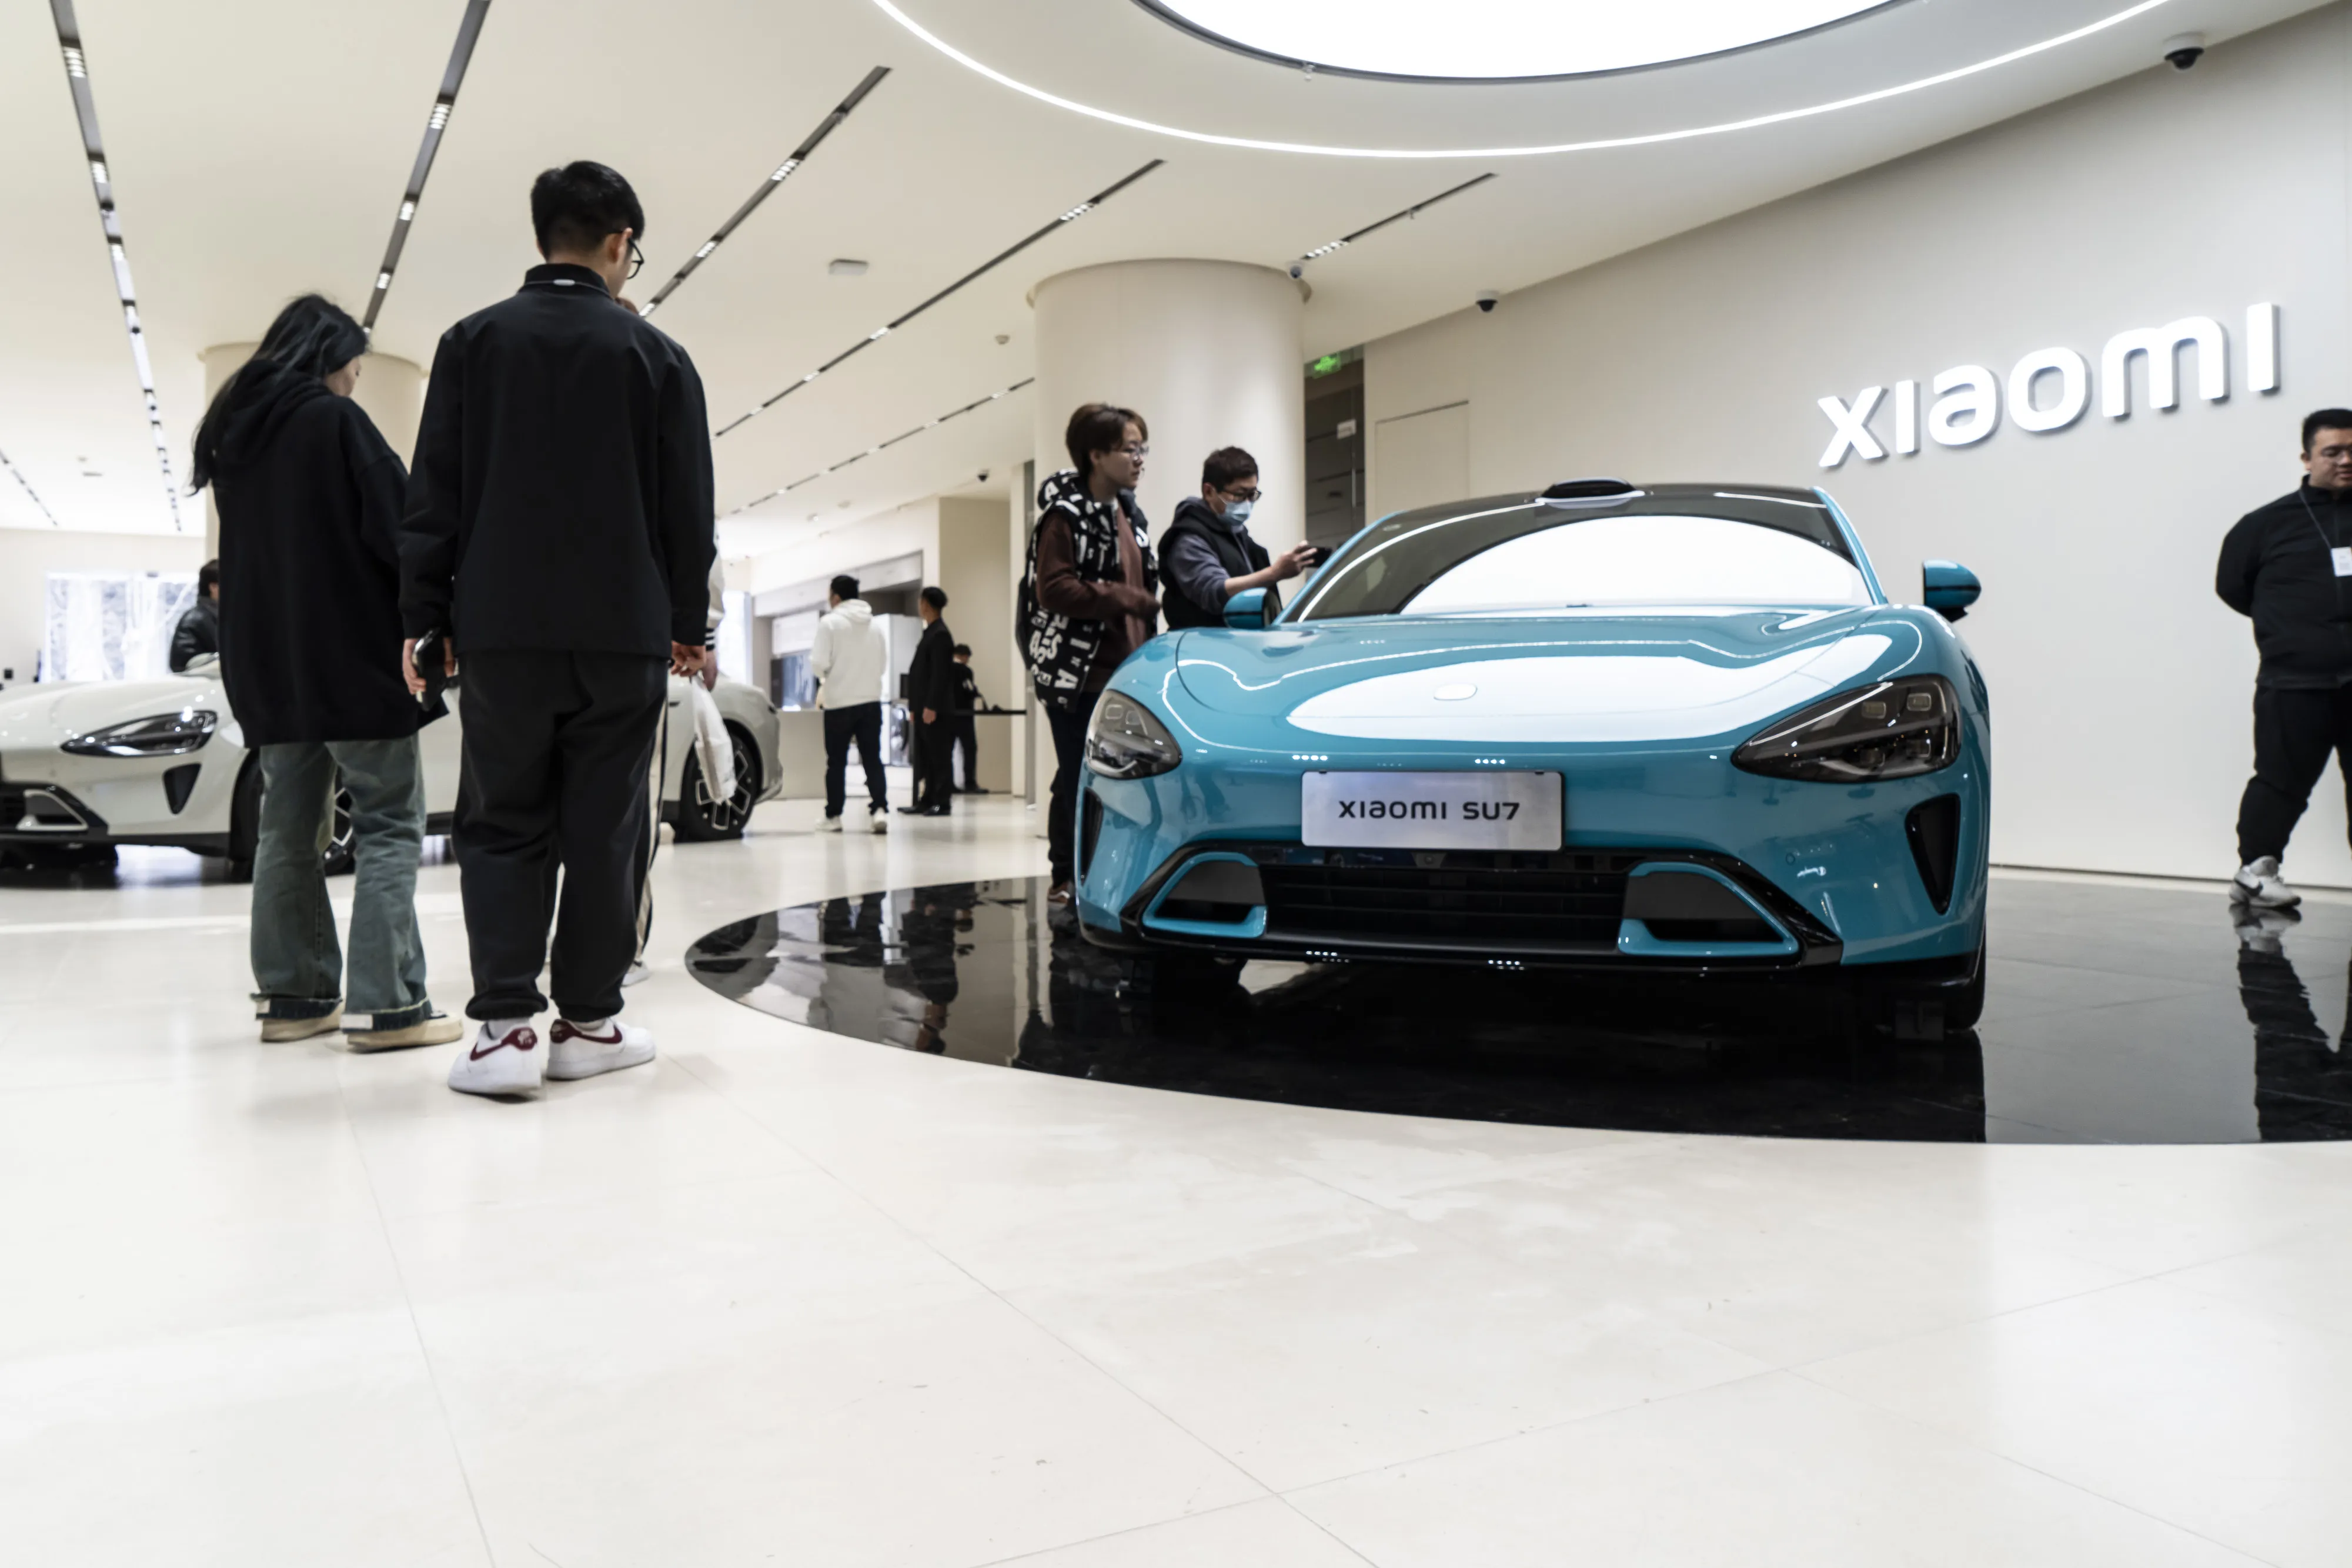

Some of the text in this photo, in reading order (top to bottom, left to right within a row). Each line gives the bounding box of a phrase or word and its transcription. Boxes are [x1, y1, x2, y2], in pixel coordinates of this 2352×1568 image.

[1818, 302, 2279, 468] xiaomi
[1339, 800, 1520, 821] xiaomi SU7
